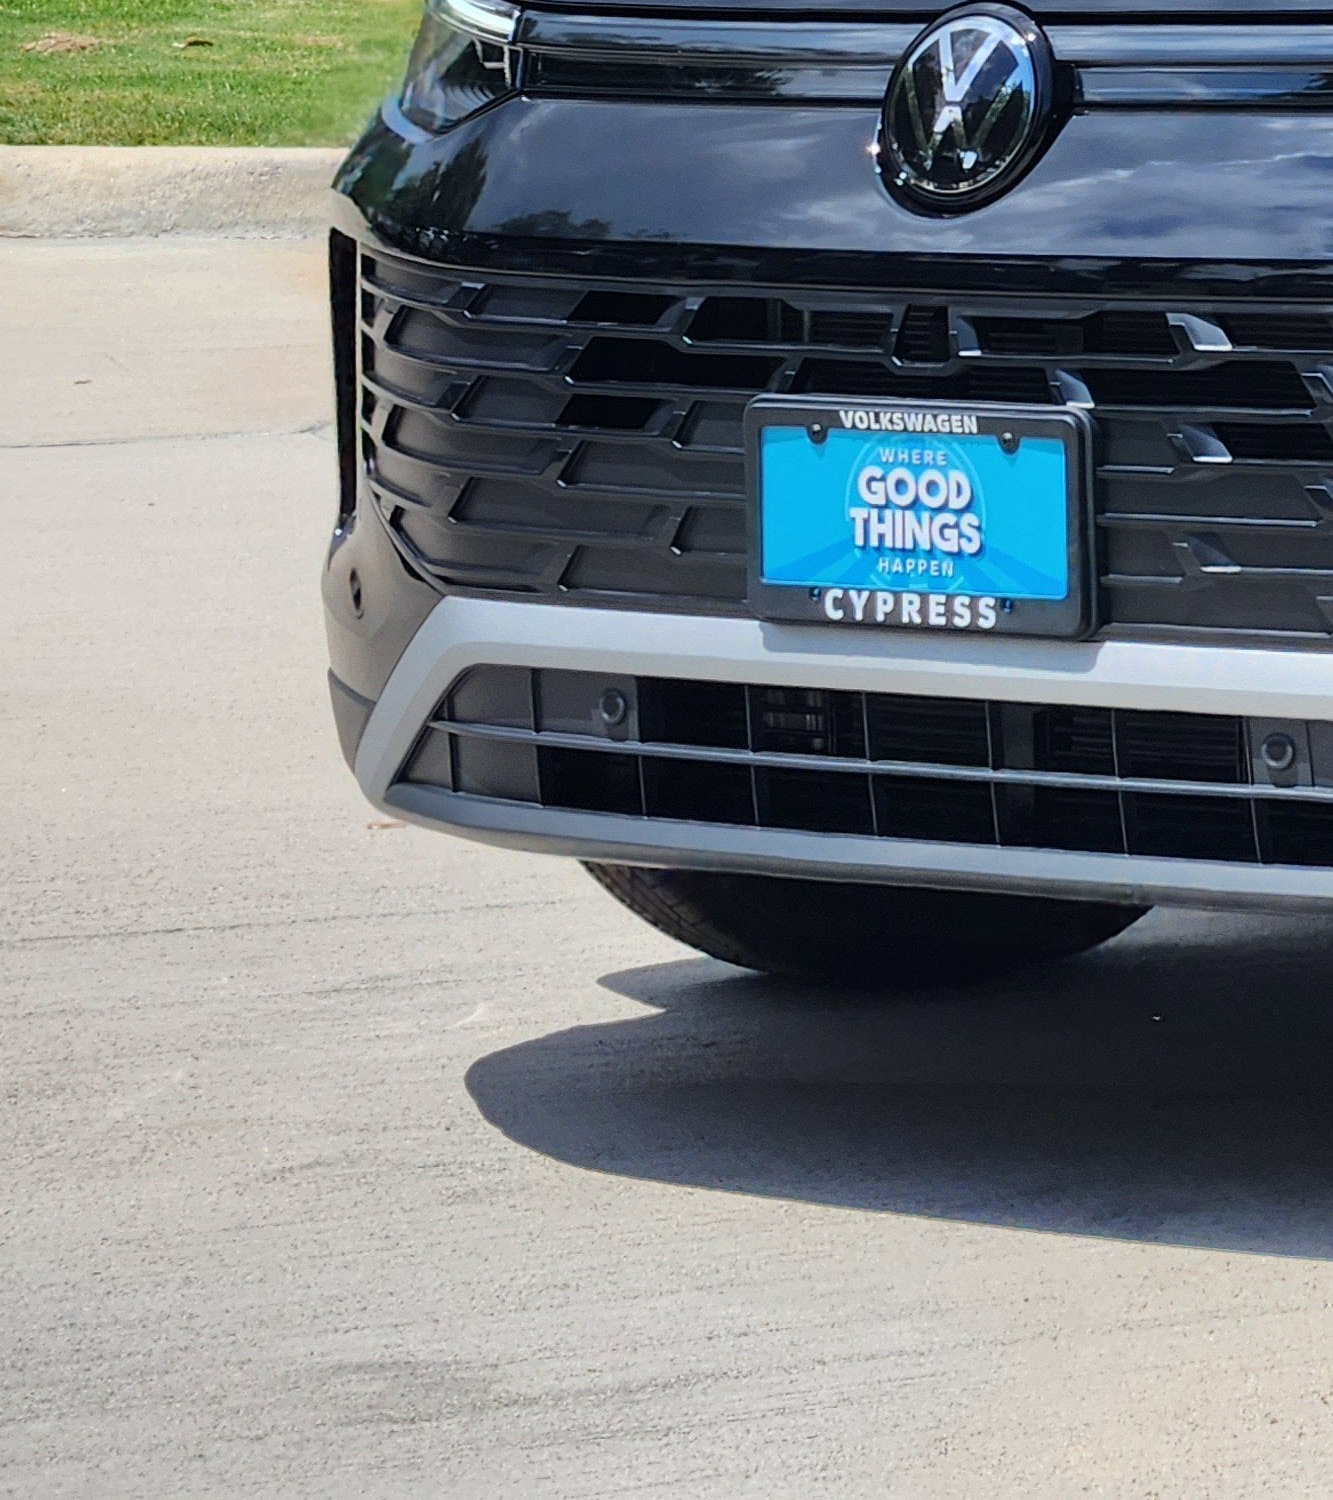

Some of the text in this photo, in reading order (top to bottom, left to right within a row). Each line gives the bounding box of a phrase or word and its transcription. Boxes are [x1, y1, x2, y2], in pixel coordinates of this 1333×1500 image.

[839, 410, 979, 434] VOLKSWAGEN
[879, 448, 948, 466] WHERE
[857, 465, 972, 511] GOOD
[850, 507, 982, 555] THINGS
[878, 557, 955, 577] HAPPEN
[823, 587, 998, 630] CYPRESS
